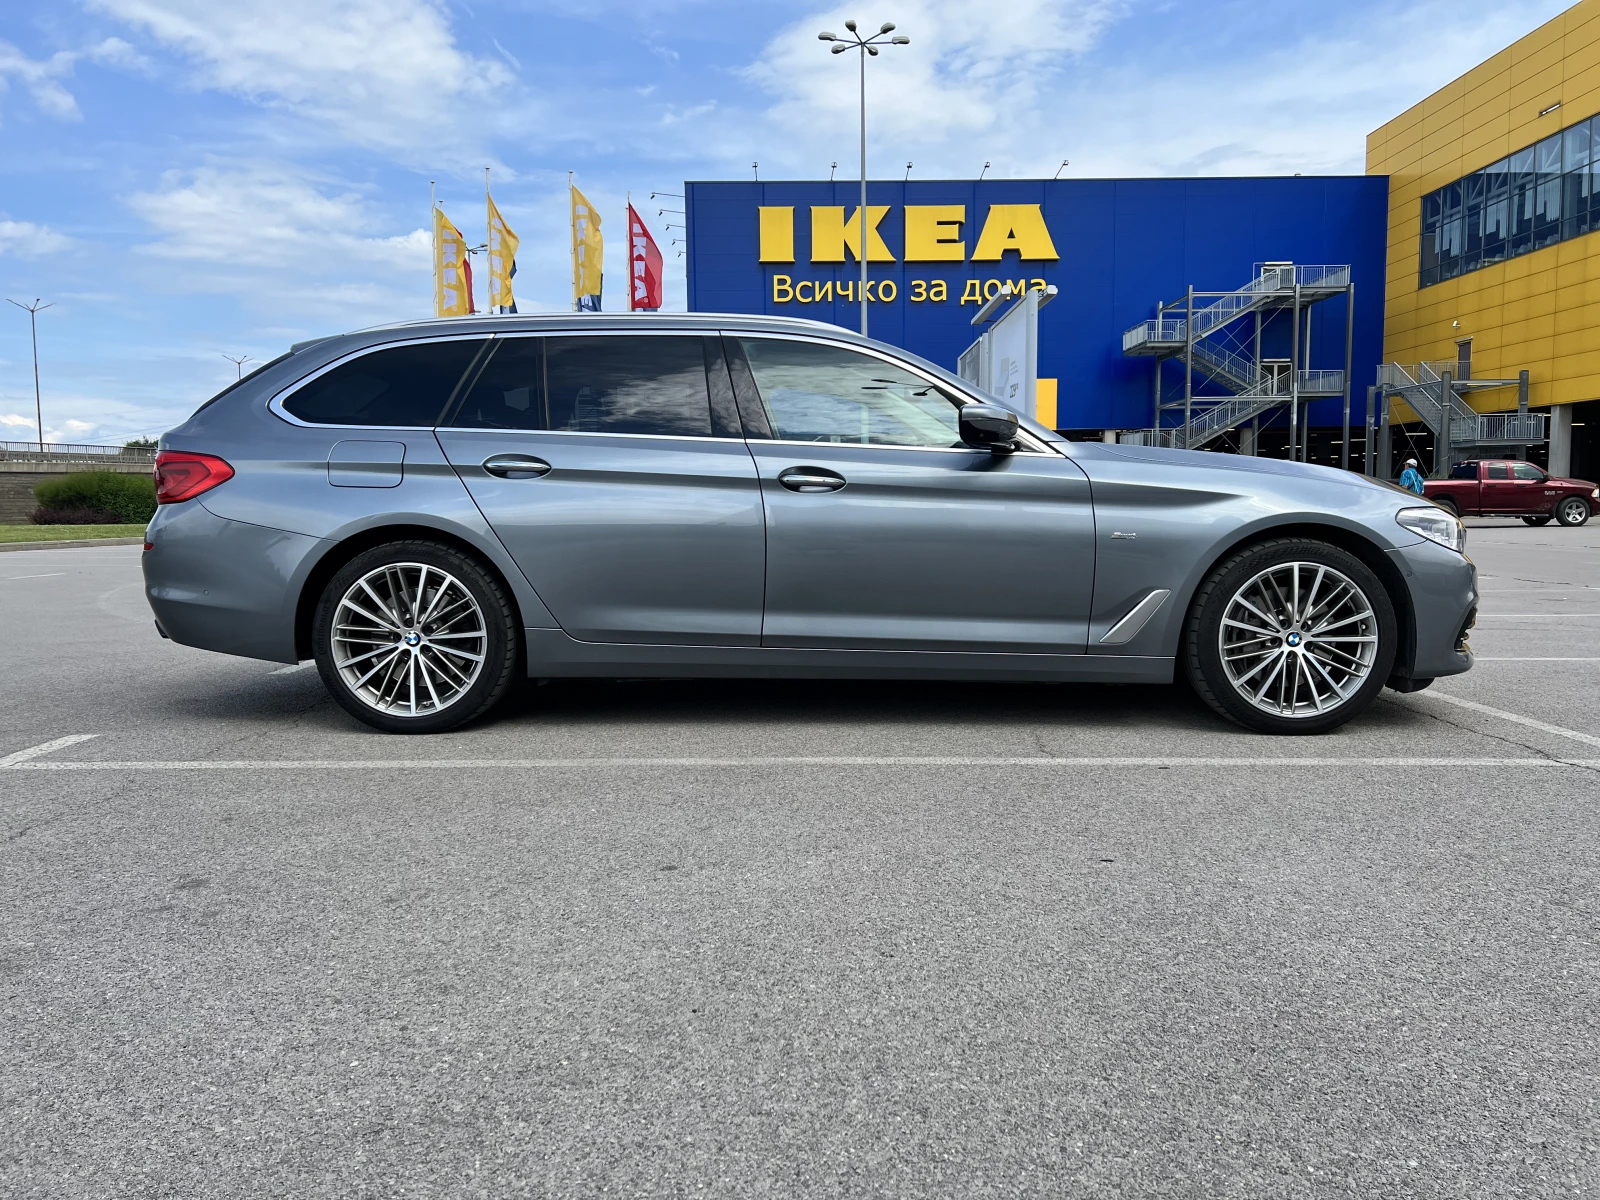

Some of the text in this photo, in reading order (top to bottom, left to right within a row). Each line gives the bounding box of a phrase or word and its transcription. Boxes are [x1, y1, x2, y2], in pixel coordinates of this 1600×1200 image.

[632, 222, 648, 302] IKEA
[758, 204, 1060, 262] IKEA
[442, 229, 457, 310] IKEA
[772, 274, 897, 302] Всичко
[910, 279, 947, 302] за
